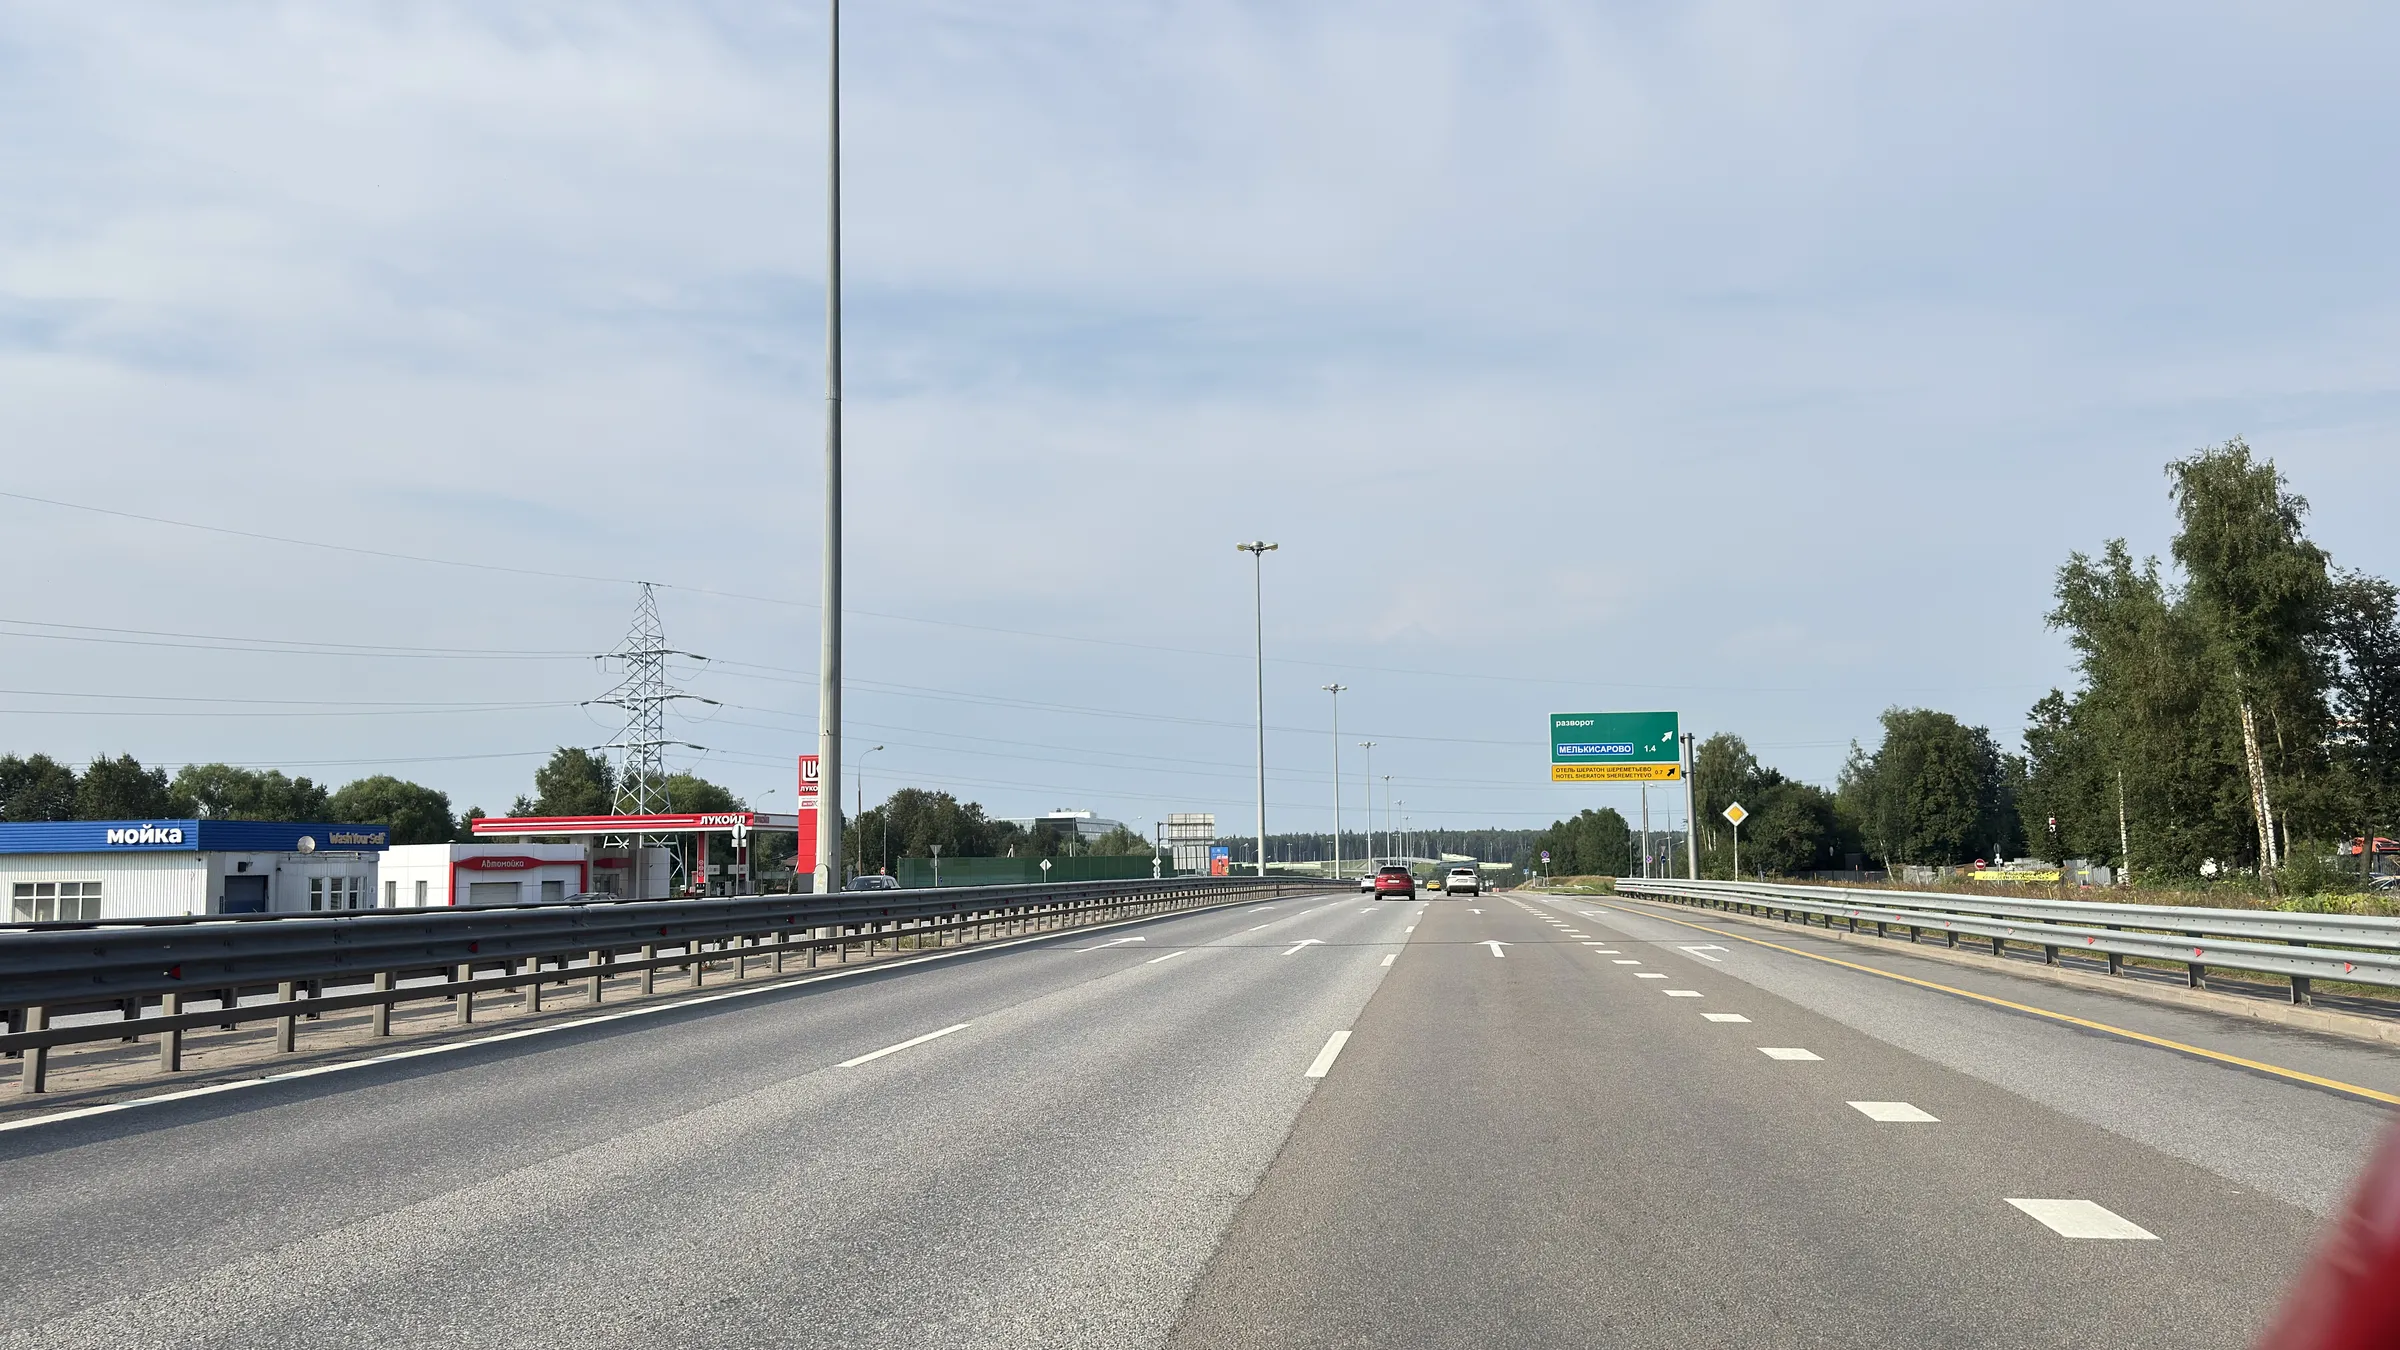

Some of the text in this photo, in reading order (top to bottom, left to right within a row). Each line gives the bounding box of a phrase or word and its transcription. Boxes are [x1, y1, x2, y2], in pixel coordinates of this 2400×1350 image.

[1556, 719, 1594, 727] разворот
[1559, 745, 1632, 753] МЕЛЬКИСАРОВО
[700, 813, 746, 825] ЛУКОЙЛ
[107, 823, 182, 844] мойка
[481, 860, 525, 868] Автомойка
